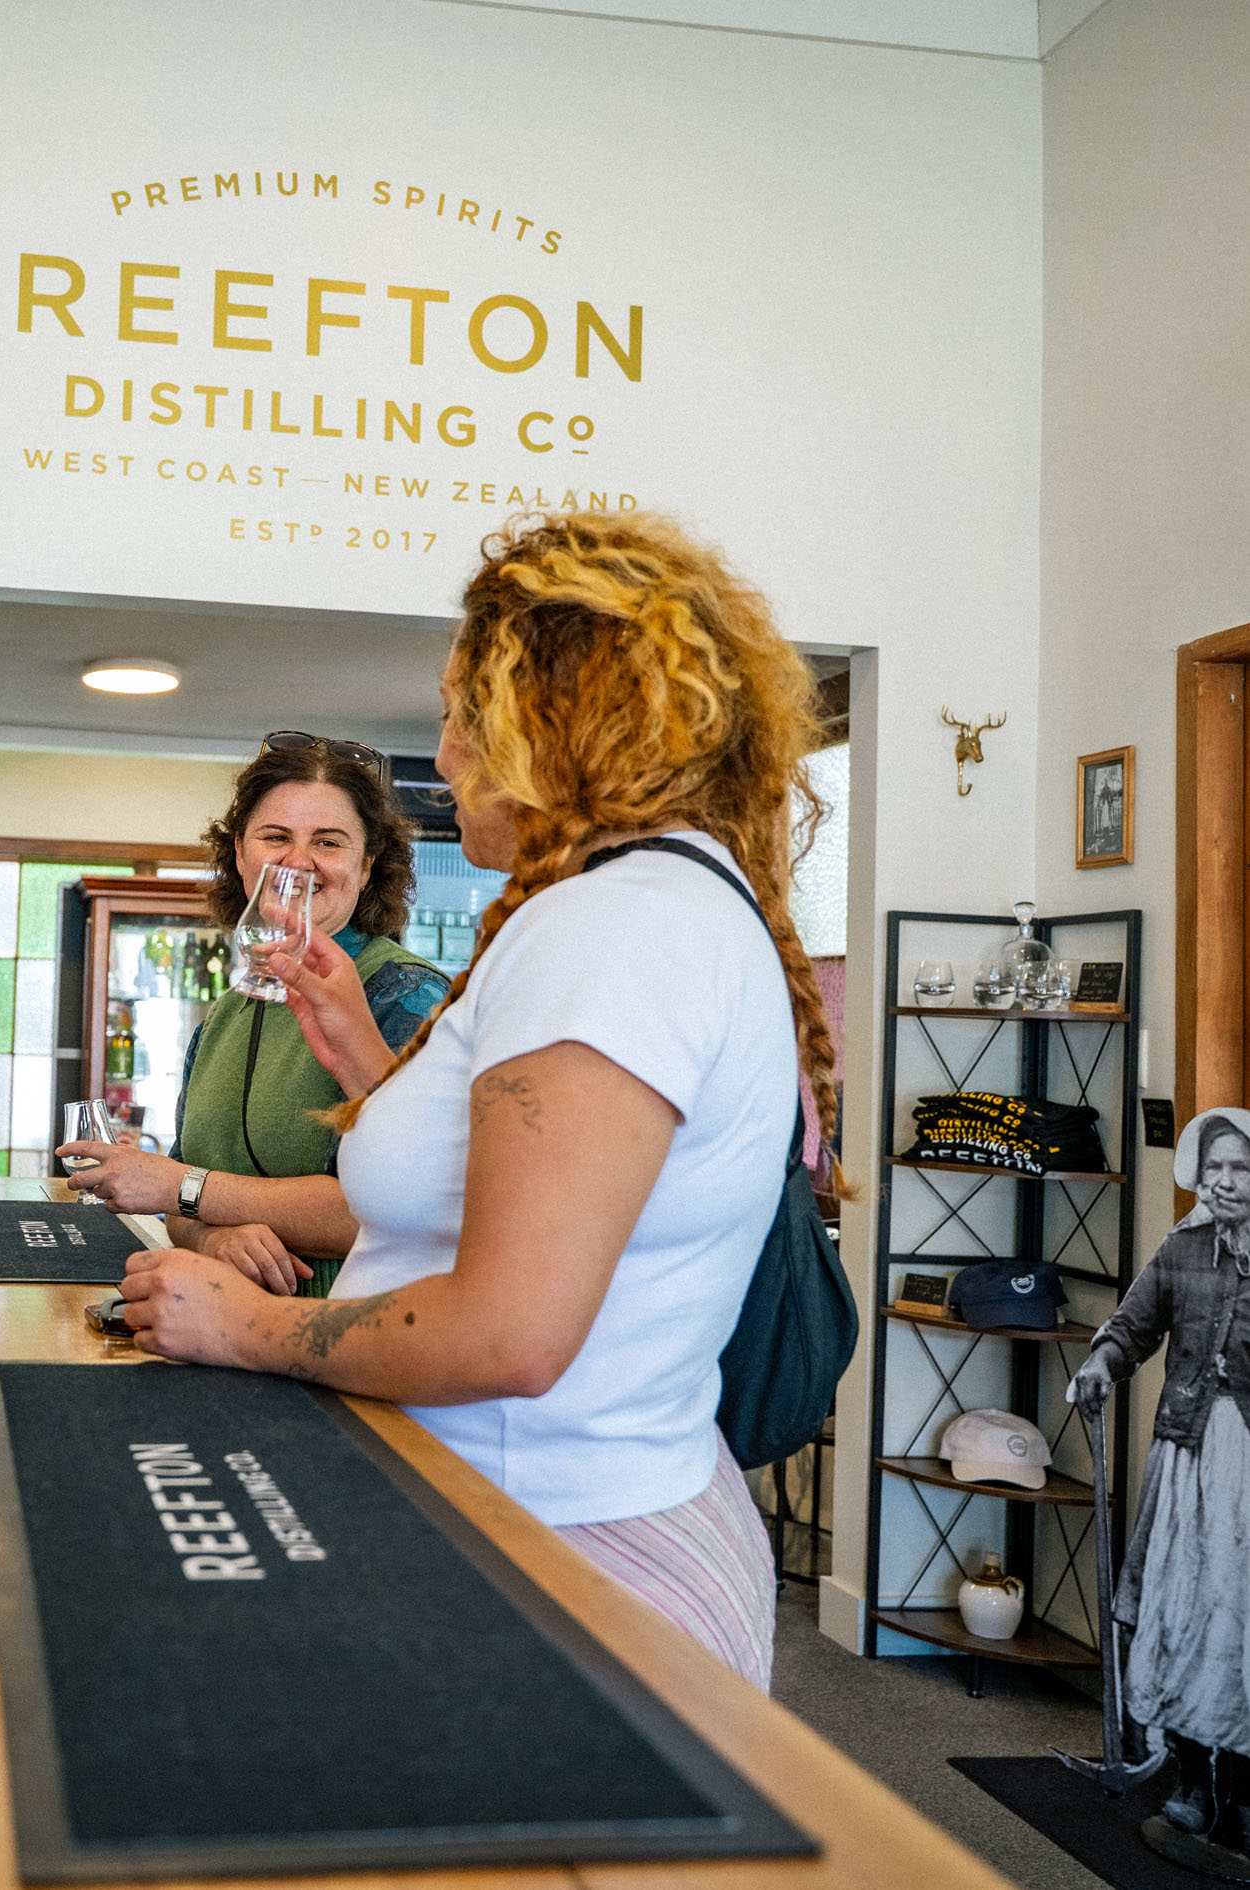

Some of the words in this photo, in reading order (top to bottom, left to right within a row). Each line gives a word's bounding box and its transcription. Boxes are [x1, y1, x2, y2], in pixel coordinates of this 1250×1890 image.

[110, 171, 339, 216] PREMIUM
[373, 180, 562, 255] SPIRITS
[16, 252, 644, 383] REEFTON
[64, 374, 478, 448] DISTILLING
[23, 447, 135, 477] WEST
[157, 458, 291, 489] COAST
[344, 472, 431, 500] NEW
[452, 481, 637, 512] ZEALAND
[345, 526, 438, 553] 2017
[128, 1443, 267, 1581] REEFTON
